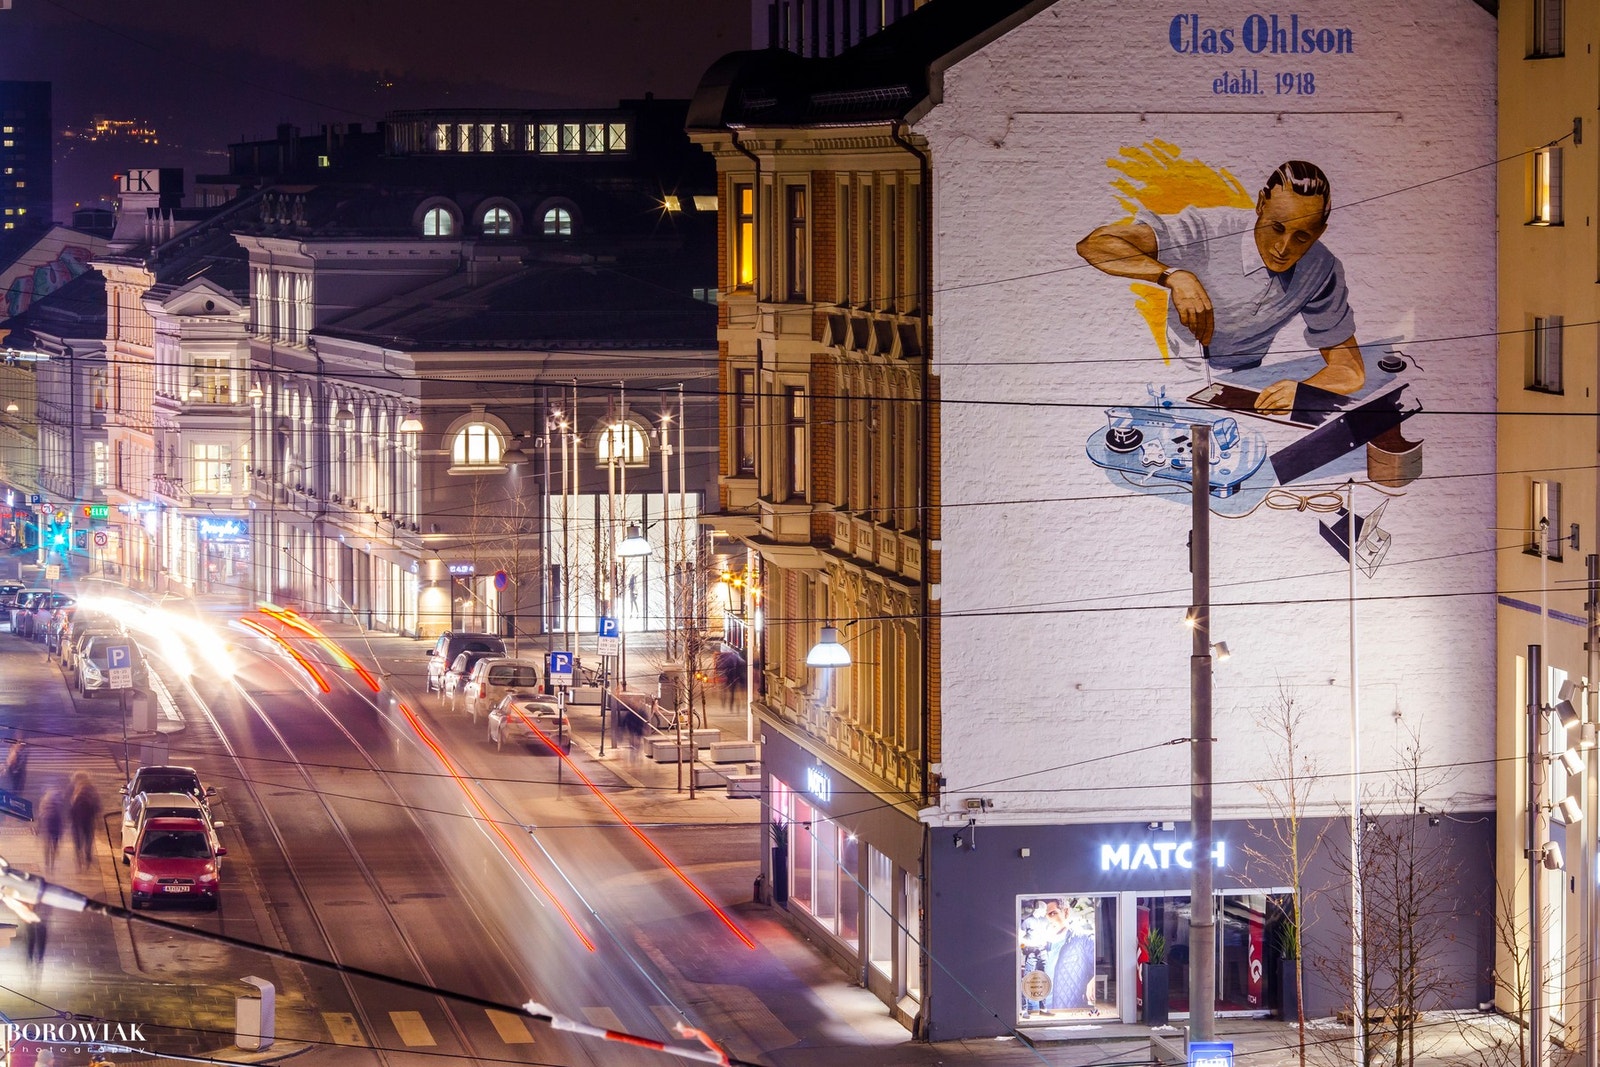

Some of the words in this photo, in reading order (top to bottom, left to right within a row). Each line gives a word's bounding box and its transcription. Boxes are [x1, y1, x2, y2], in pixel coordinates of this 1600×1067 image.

[1169, 13, 1235, 54] Clas
[1242, 13, 1354, 54] Ohlson
[1274, 72, 1316, 95] 1918
[125, 170, 154, 191] HK
[603, 619, 615, 635] P
[112, 649, 125, 666] P
[556, 654, 569, 671] P
[1101, 841, 1225, 871] MATCH
